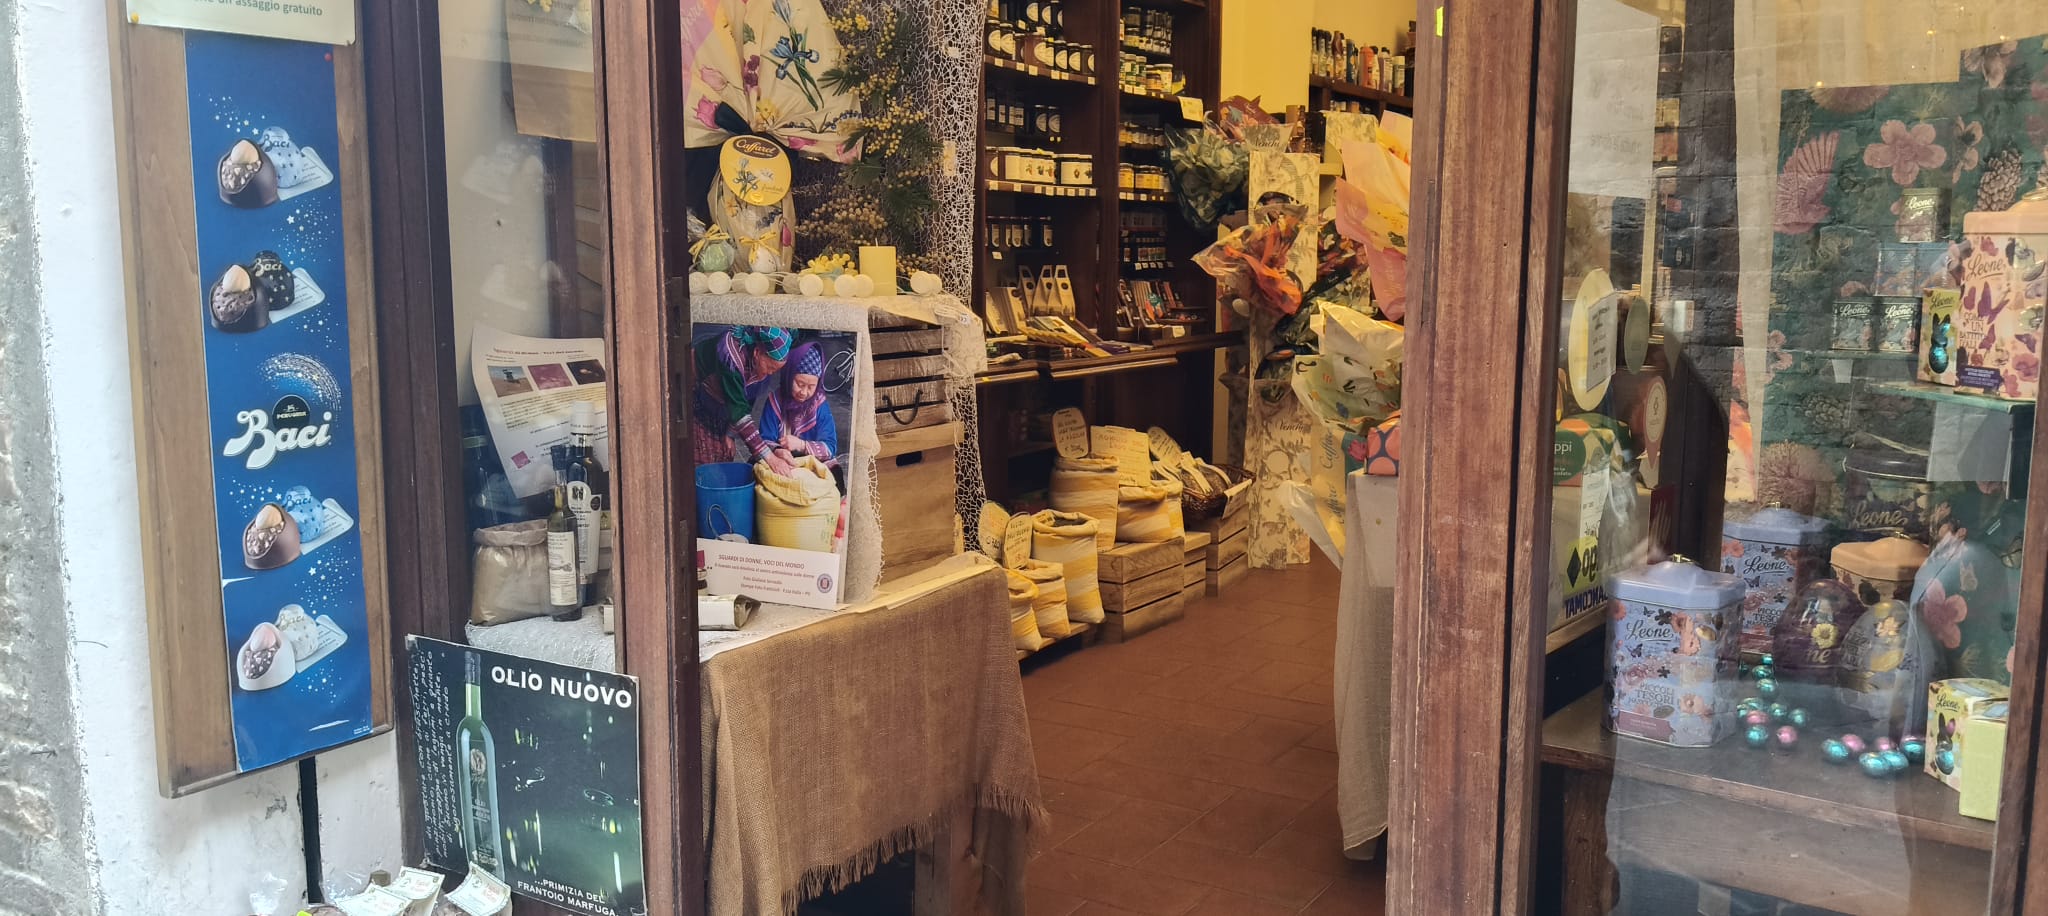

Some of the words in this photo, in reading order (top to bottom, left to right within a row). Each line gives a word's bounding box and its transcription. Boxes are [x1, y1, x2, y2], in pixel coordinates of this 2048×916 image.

[282, 2, 323, 17] gratuito
[257, 134, 290, 153] Baci
[735, 140, 777, 154] Caffarel
[1905, 196, 1935, 210] Leone
[252, 258, 283, 277] Baci
[1966, 253, 2006, 281] Leone
[1839, 304, 1870, 317] Leone
[1885, 304, 1914, 318] Leone
[223, 408, 332, 470] Baci
[281, 494, 312, 513] Baci
[1852, 508, 1908, 528] Leone
[1743, 556, 1790, 574] Leone
[1626, 619, 1674, 641] Leone
[491, 665, 543, 692] OLIO
[551, 676, 633, 709] NUOVO
[442, 686, 451, 726] crudo
[1635, 689, 1675, 705] TESORI
[1936, 693, 1960, 712] Leone
[517, 880, 565, 902] FRANTOIO
[586, 892, 606, 904] DEL
